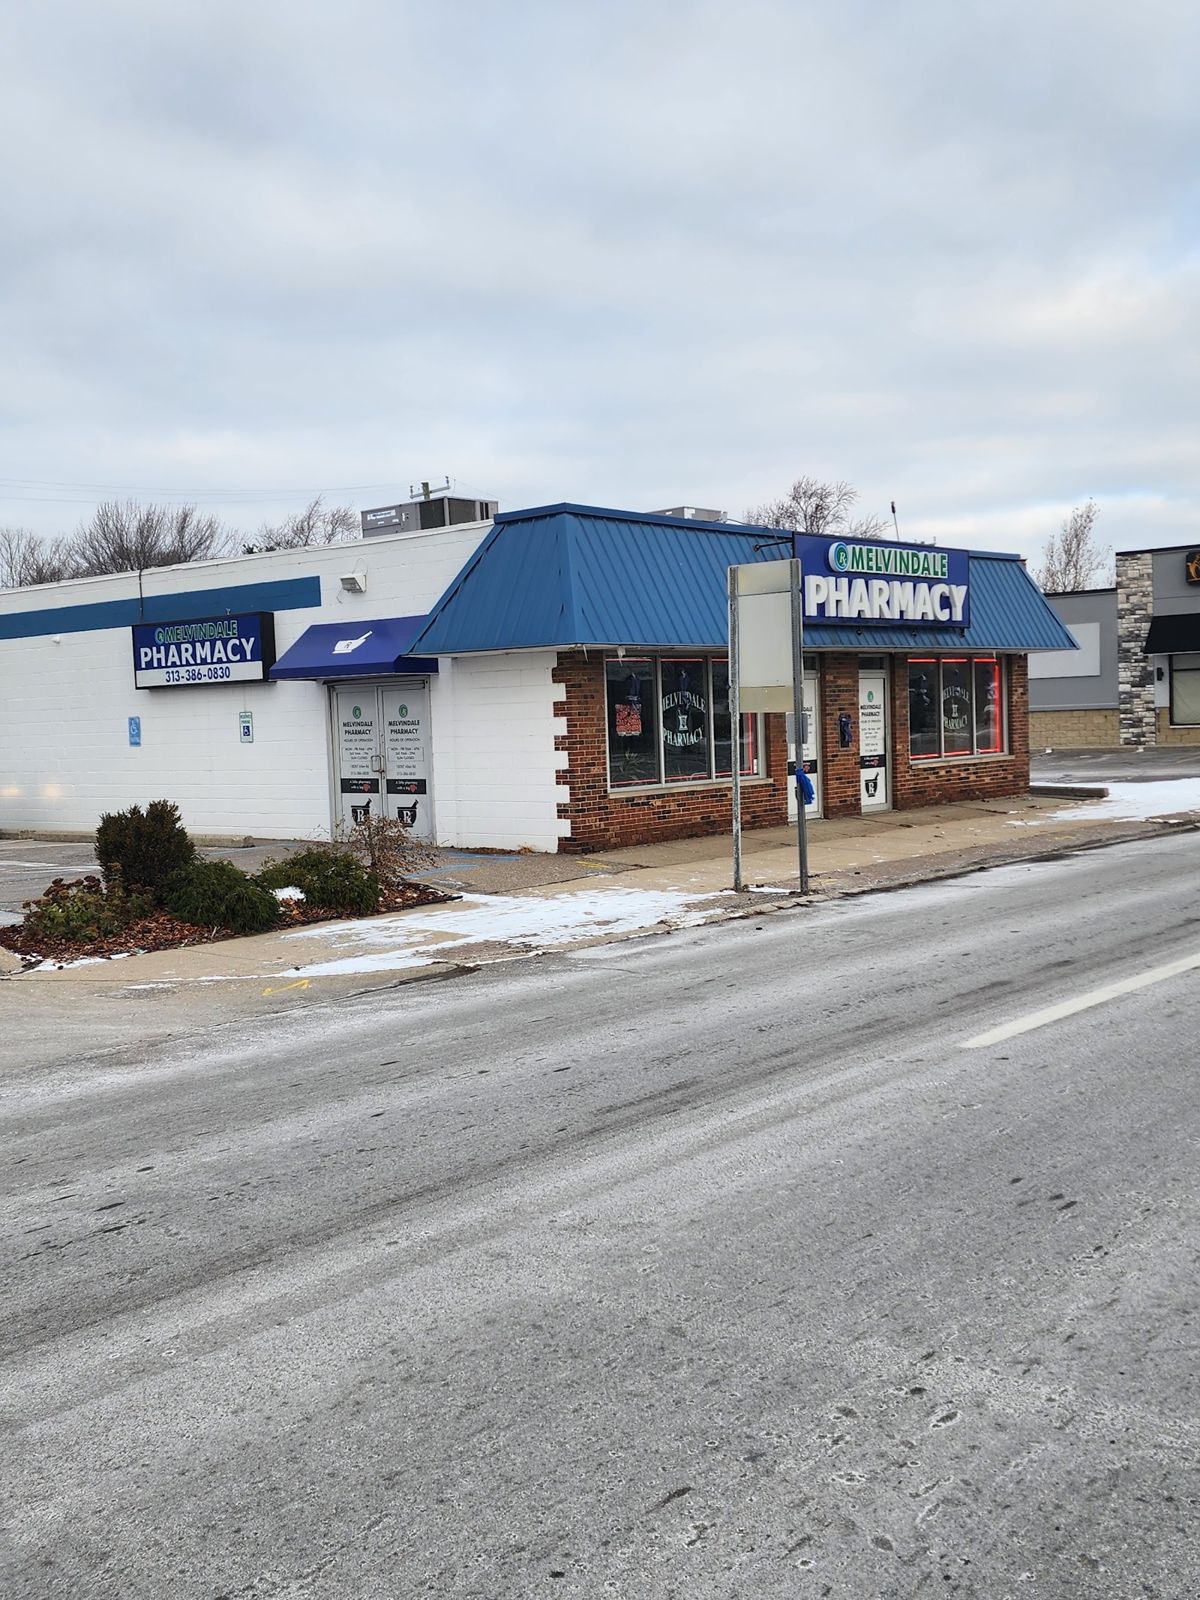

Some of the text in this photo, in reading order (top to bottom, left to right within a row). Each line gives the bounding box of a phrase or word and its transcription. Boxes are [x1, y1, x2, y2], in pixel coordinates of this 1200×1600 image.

[850, 545, 948, 578] MELVINDALE
[804, 575, 968, 621] PHARMACY
[165, 620, 238, 643] MELVINDALE
[140, 637, 255, 669] PHARMACY
[165, 666, 231, 683] 313-386-0830
[342, 720, 373, 728] MELVINDALE
[388, 719, 420, 727] MELVINDALE
